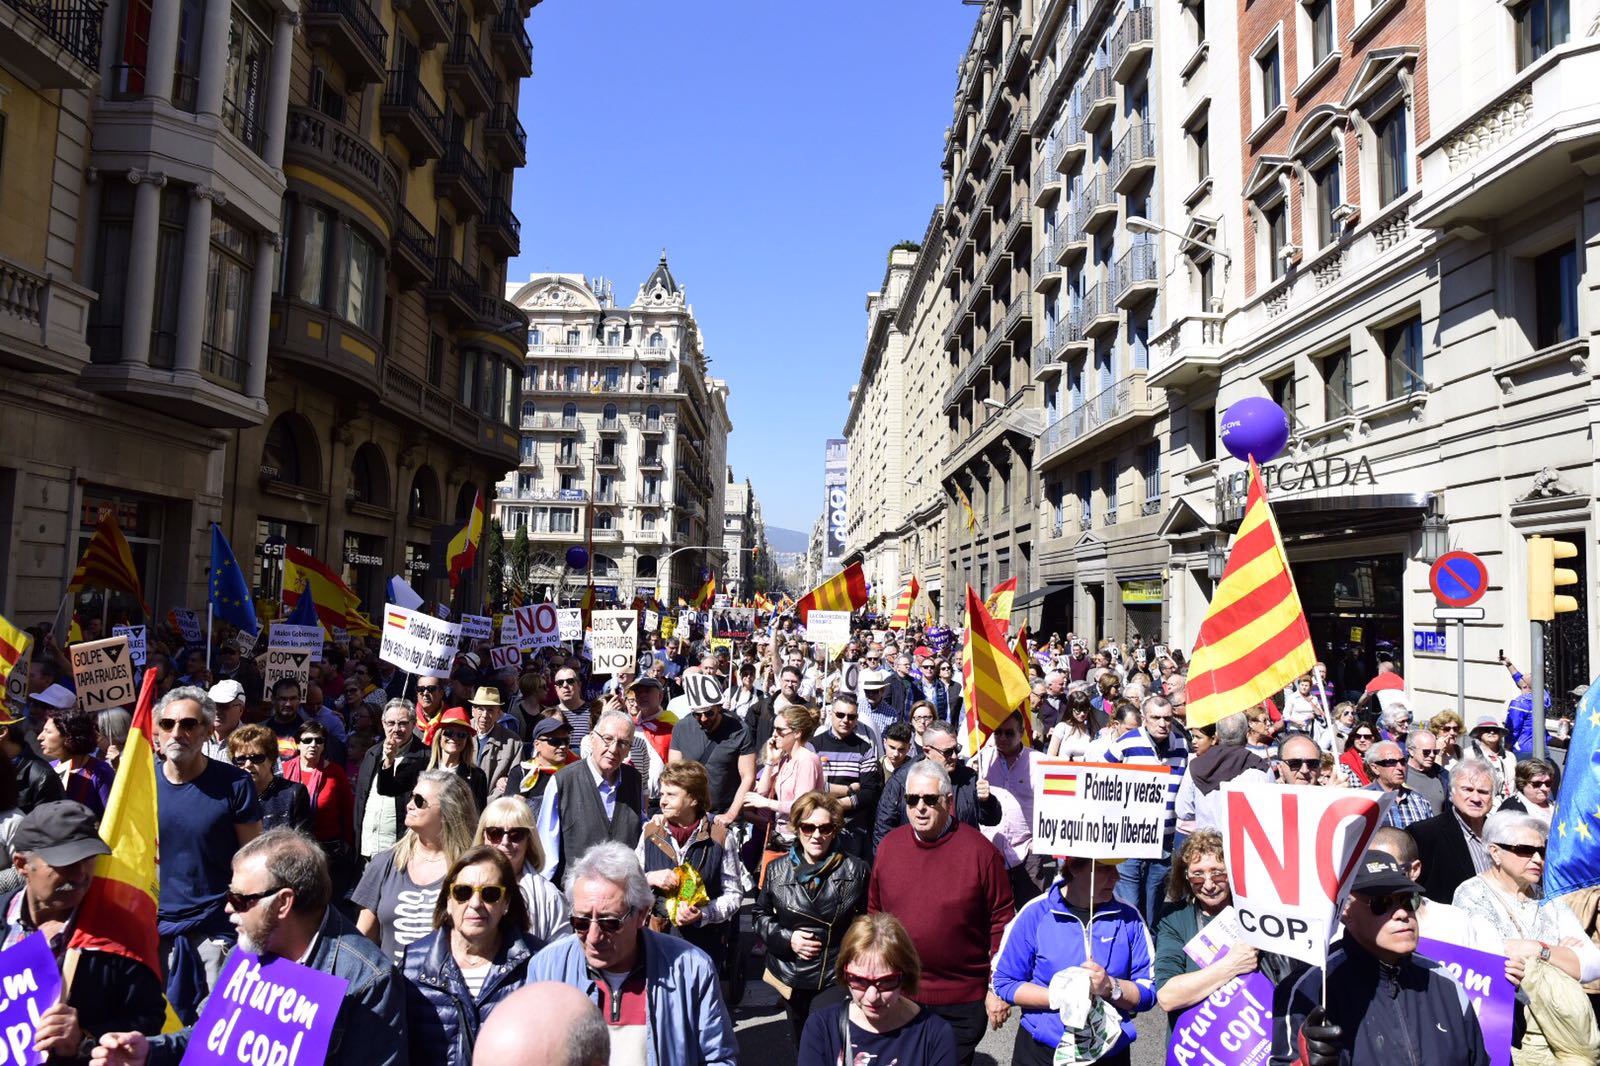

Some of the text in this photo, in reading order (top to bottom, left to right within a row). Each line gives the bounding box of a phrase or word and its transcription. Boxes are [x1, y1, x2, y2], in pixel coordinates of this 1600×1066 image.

[264, 543, 284, 555] G-ST
[292, 630, 320, 638] Gobiernos
[408, 617, 431, 640] Póntela
[429, 629, 437, 646] y
[436, 629, 458, 648] verás:
[514, 604, 557, 637] NO
[593, 617, 614, 631] GOLPE
[73, 649, 102, 667] GOLPE
[269, 651, 291, 665] COP
[382, 634, 394, 657] hoy
[410, 646, 424, 669] hay
[423, 649, 451, 671] libertad.
[491, 645, 520, 668] NO
[593, 654, 633, 671] ¡NO!
[76, 664, 129, 687] TAPA FRAUDES,
[685, 675, 723, 707] NO
[79, 683, 131, 711] ¡NO!
[1084, 773, 1166, 809] Póntela y verás:
[1038, 811, 1160, 851] hoy aquí no hay libertad.
[1227, 791, 1381, 906] NO
[1238, 908, 1313, 950] COP,
[222, 958, 319, 1031] Aturem
[207, 1007, 242, 1056] el
[1219, 988, 1273, 1053] cop!
